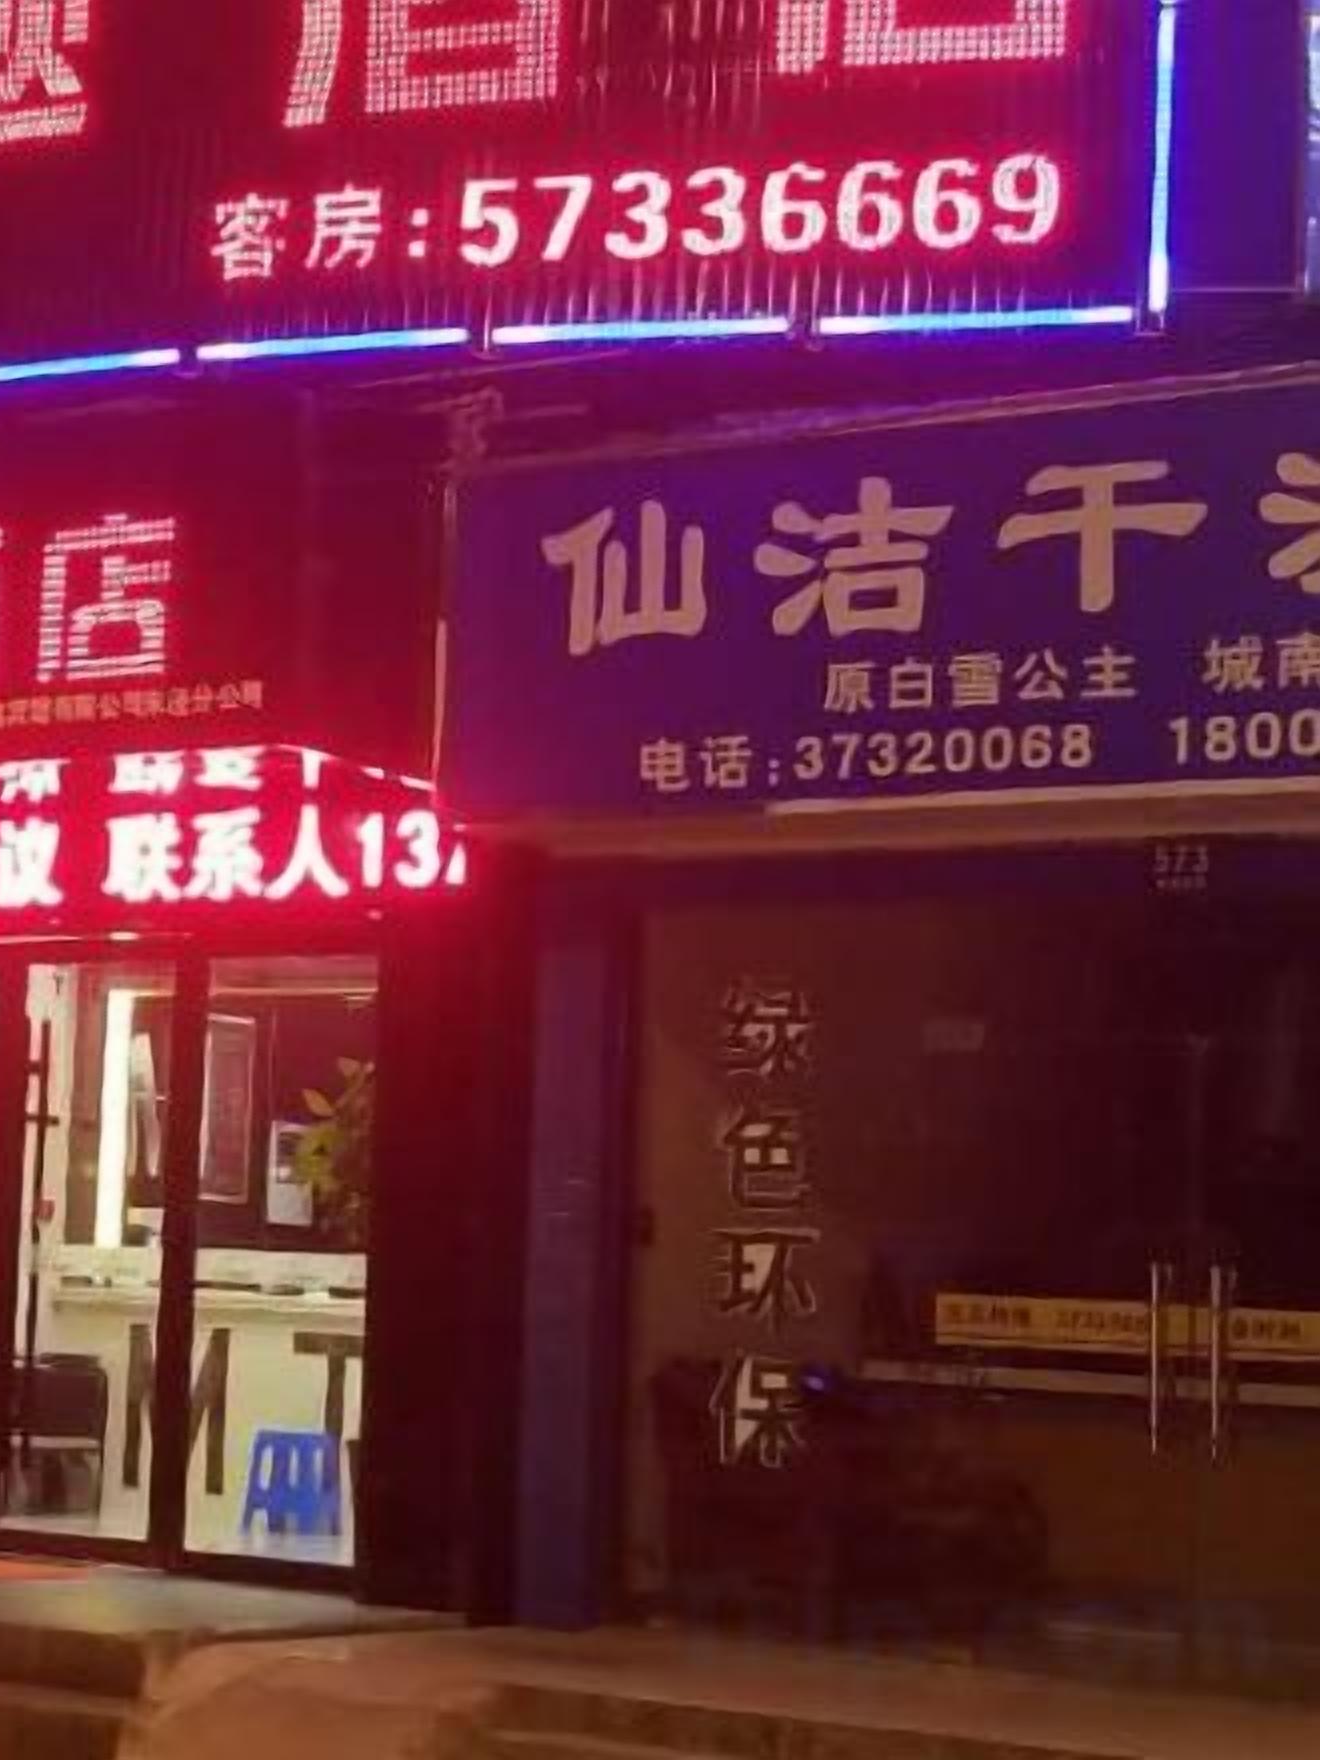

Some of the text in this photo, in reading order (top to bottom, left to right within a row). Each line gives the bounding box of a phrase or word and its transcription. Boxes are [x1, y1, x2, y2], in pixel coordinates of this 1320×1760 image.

[822, 633, 1320, 713] 原白雪公主 城南
[1169, 709, 1320, 765] 1800
[710, 990, 821, 1470] 绿色环保
